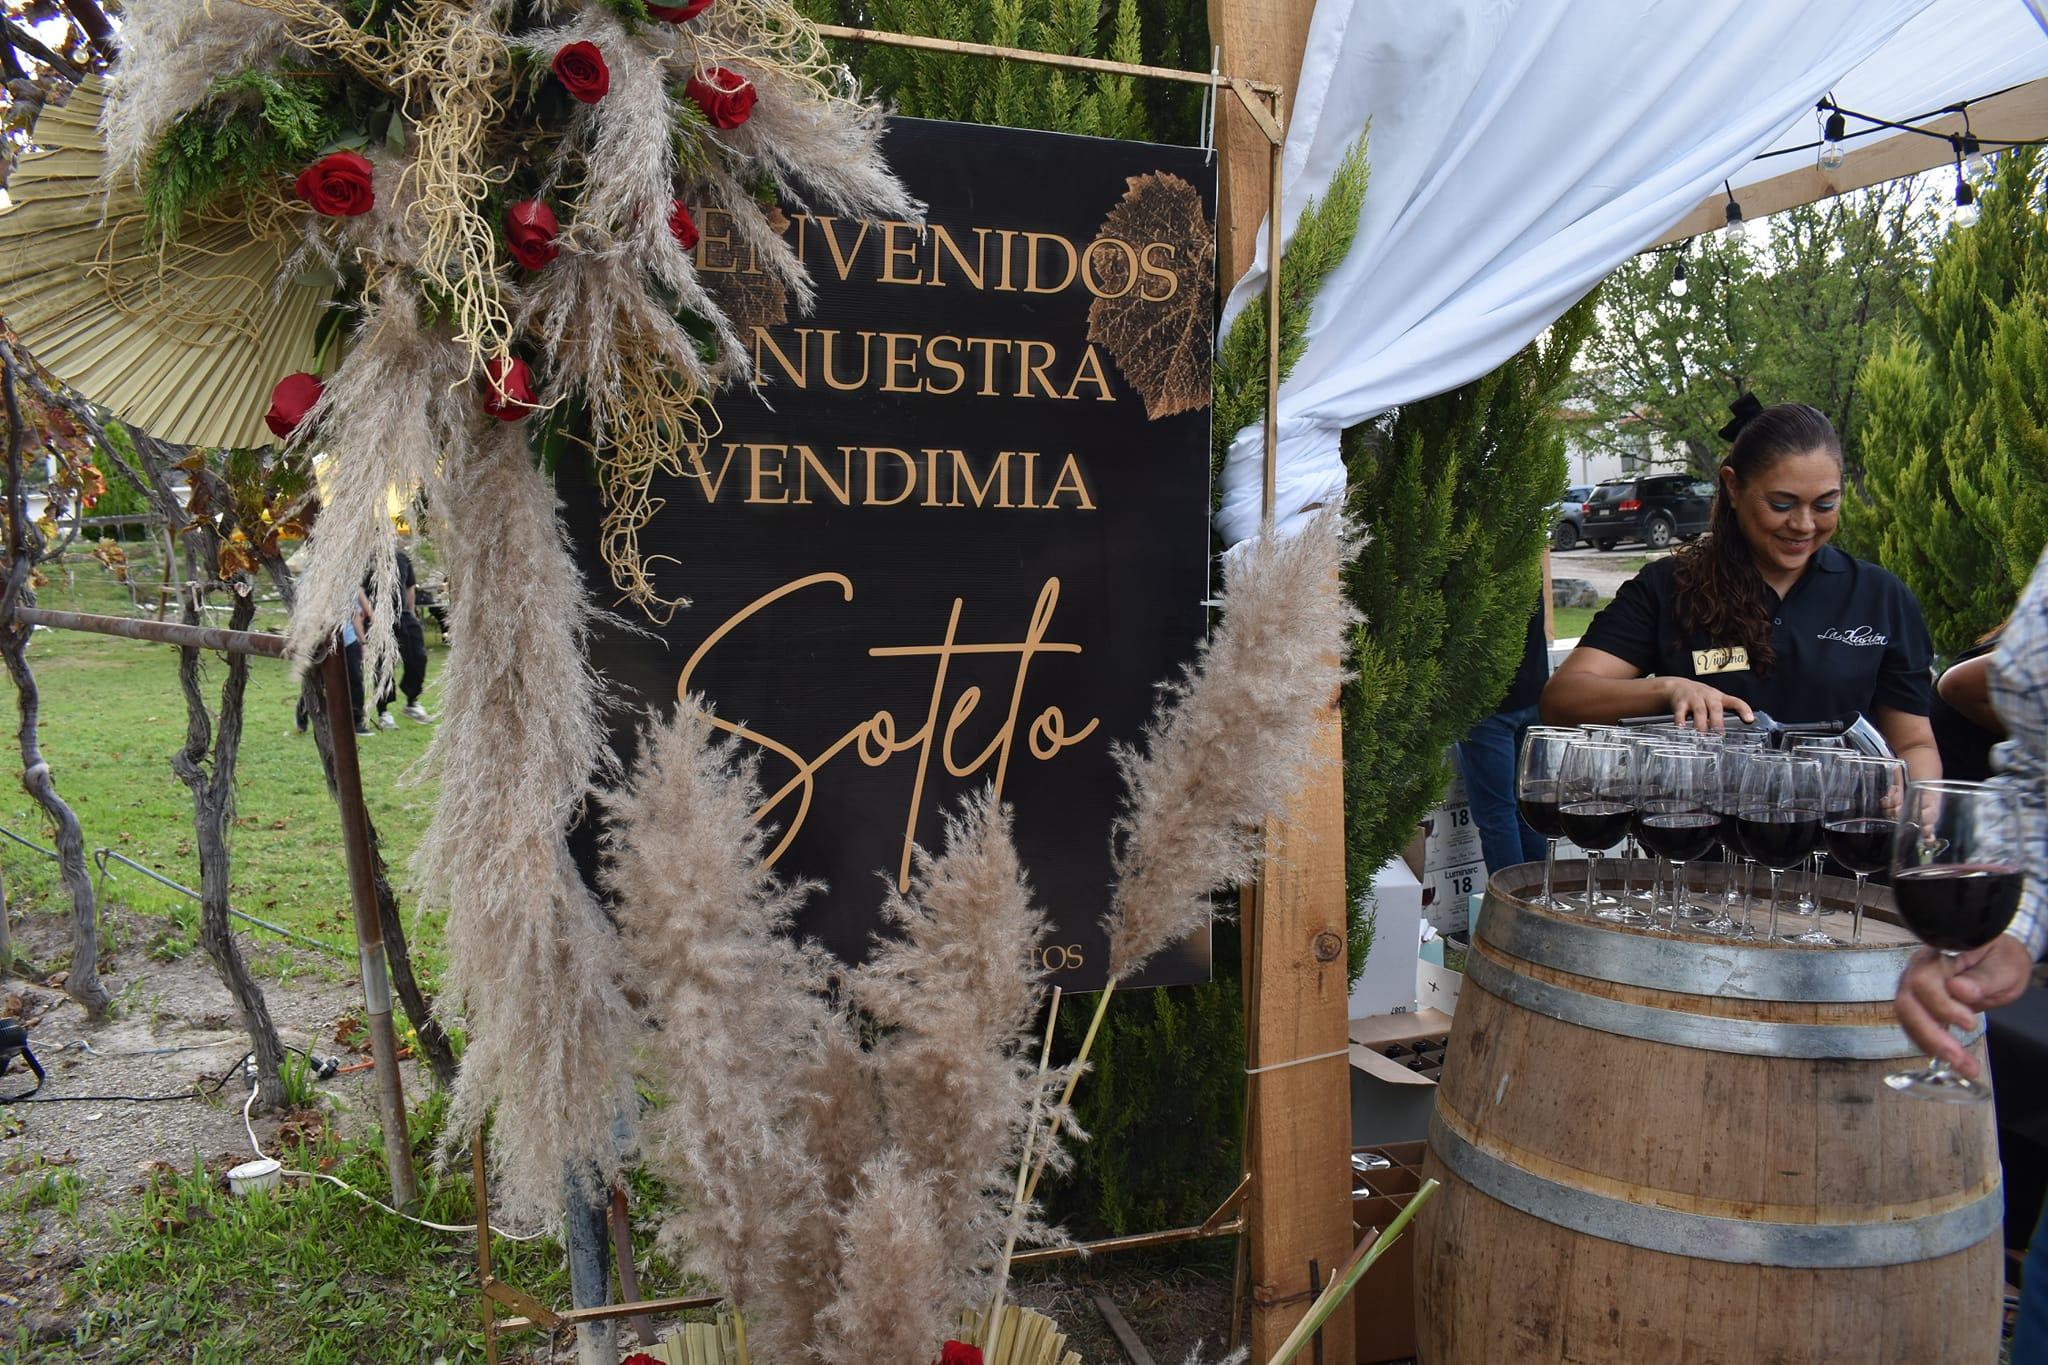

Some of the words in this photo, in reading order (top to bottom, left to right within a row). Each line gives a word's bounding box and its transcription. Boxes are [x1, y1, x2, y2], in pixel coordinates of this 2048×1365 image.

[690, 206, 1179, 302] EVENIDOS
[750, 325, 1116, 401] NUESTRA
[687, 441, 1097, 510] VENDIMIA
[1450, 808, 1470, 828] 18
[1444, 866, 1478, 879] Luminarc
[1453, 876, 1473, 895] 18
